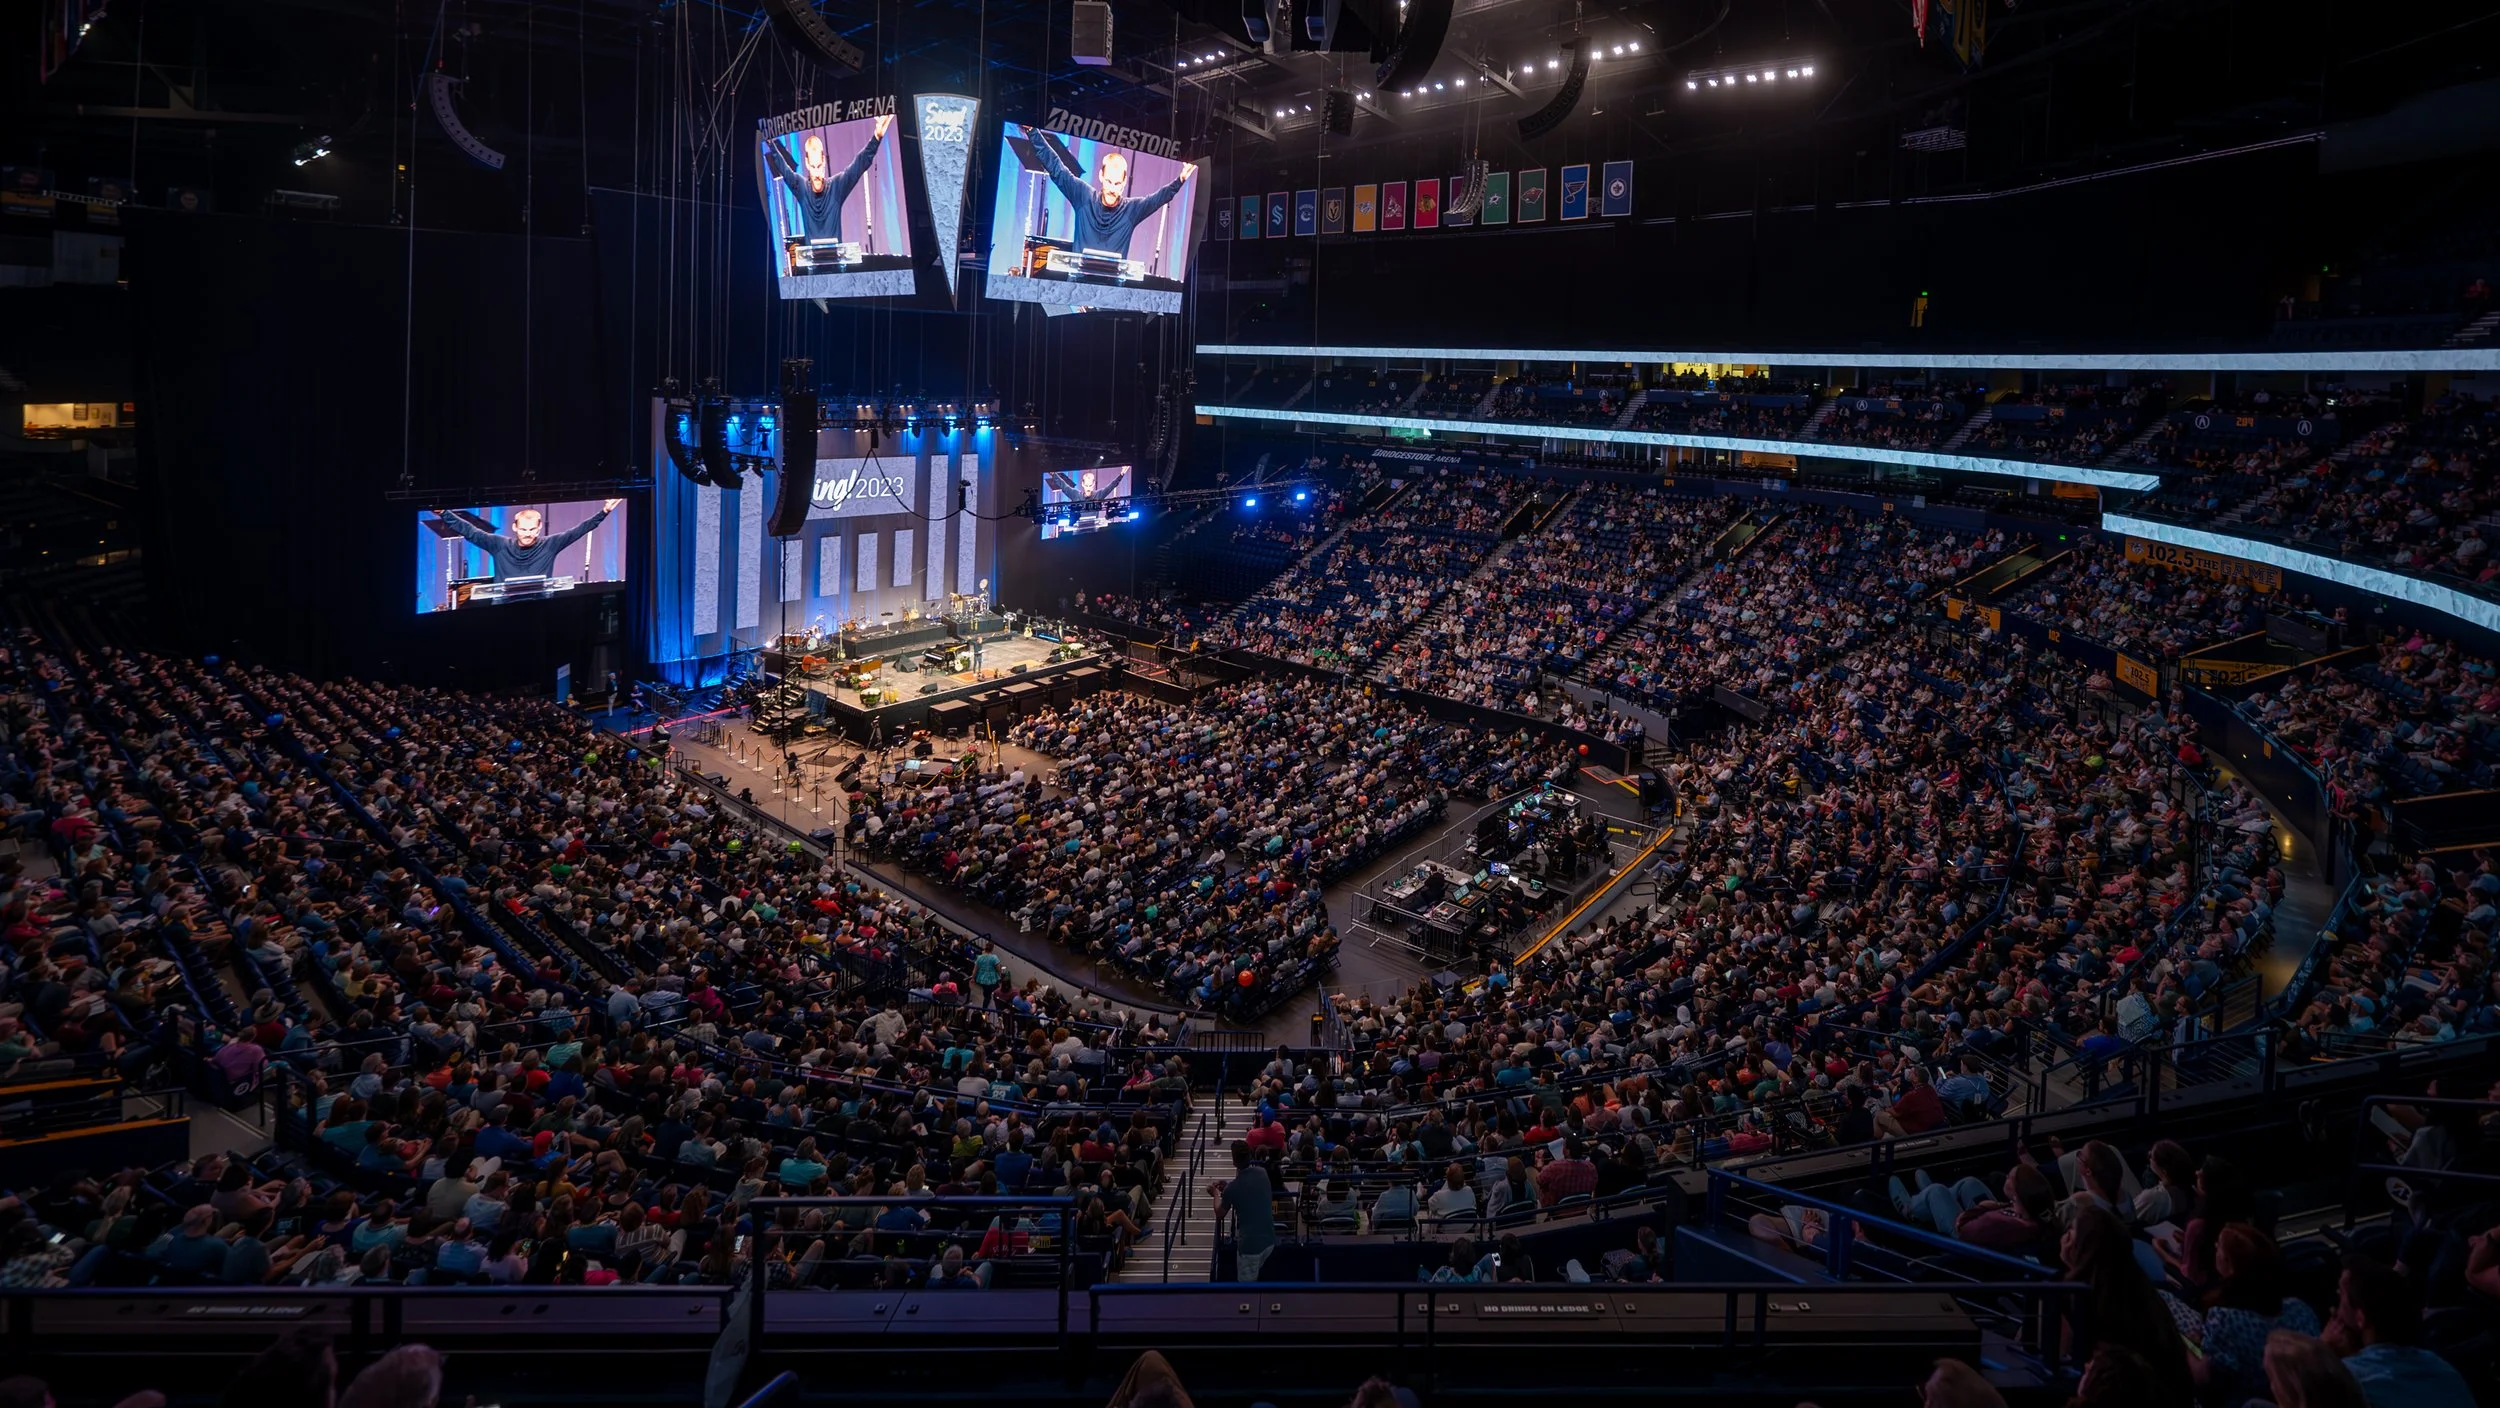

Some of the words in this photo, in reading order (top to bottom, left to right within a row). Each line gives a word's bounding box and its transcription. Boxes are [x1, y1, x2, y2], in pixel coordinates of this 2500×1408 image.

[758, 101, 842, 139] BRIDGESTONE
[846, 95, 896, 120] ARENA
[925, 126, 964, 142] 2023
[1044, 107, 1181, 159] BRIDGESTONE
[1371, 448, 1436, 461] BRIDGESTONE
[1433, 455, 1461, 463] ARENA
[855, 477, 904, 499] 2023
[2146, 543, 2194, 568] 102.5
[2196, 557, 2219, 570] THE
[2220, 559, 2278, 586] GAME
[1484, 1304, 1499, 1313] NO
[1500, 1304, 1538, 1313] DRINKS
[1540, 1304, 1554, 1313] ON
[1556, 1304, 1589, 1313] LEDGE
